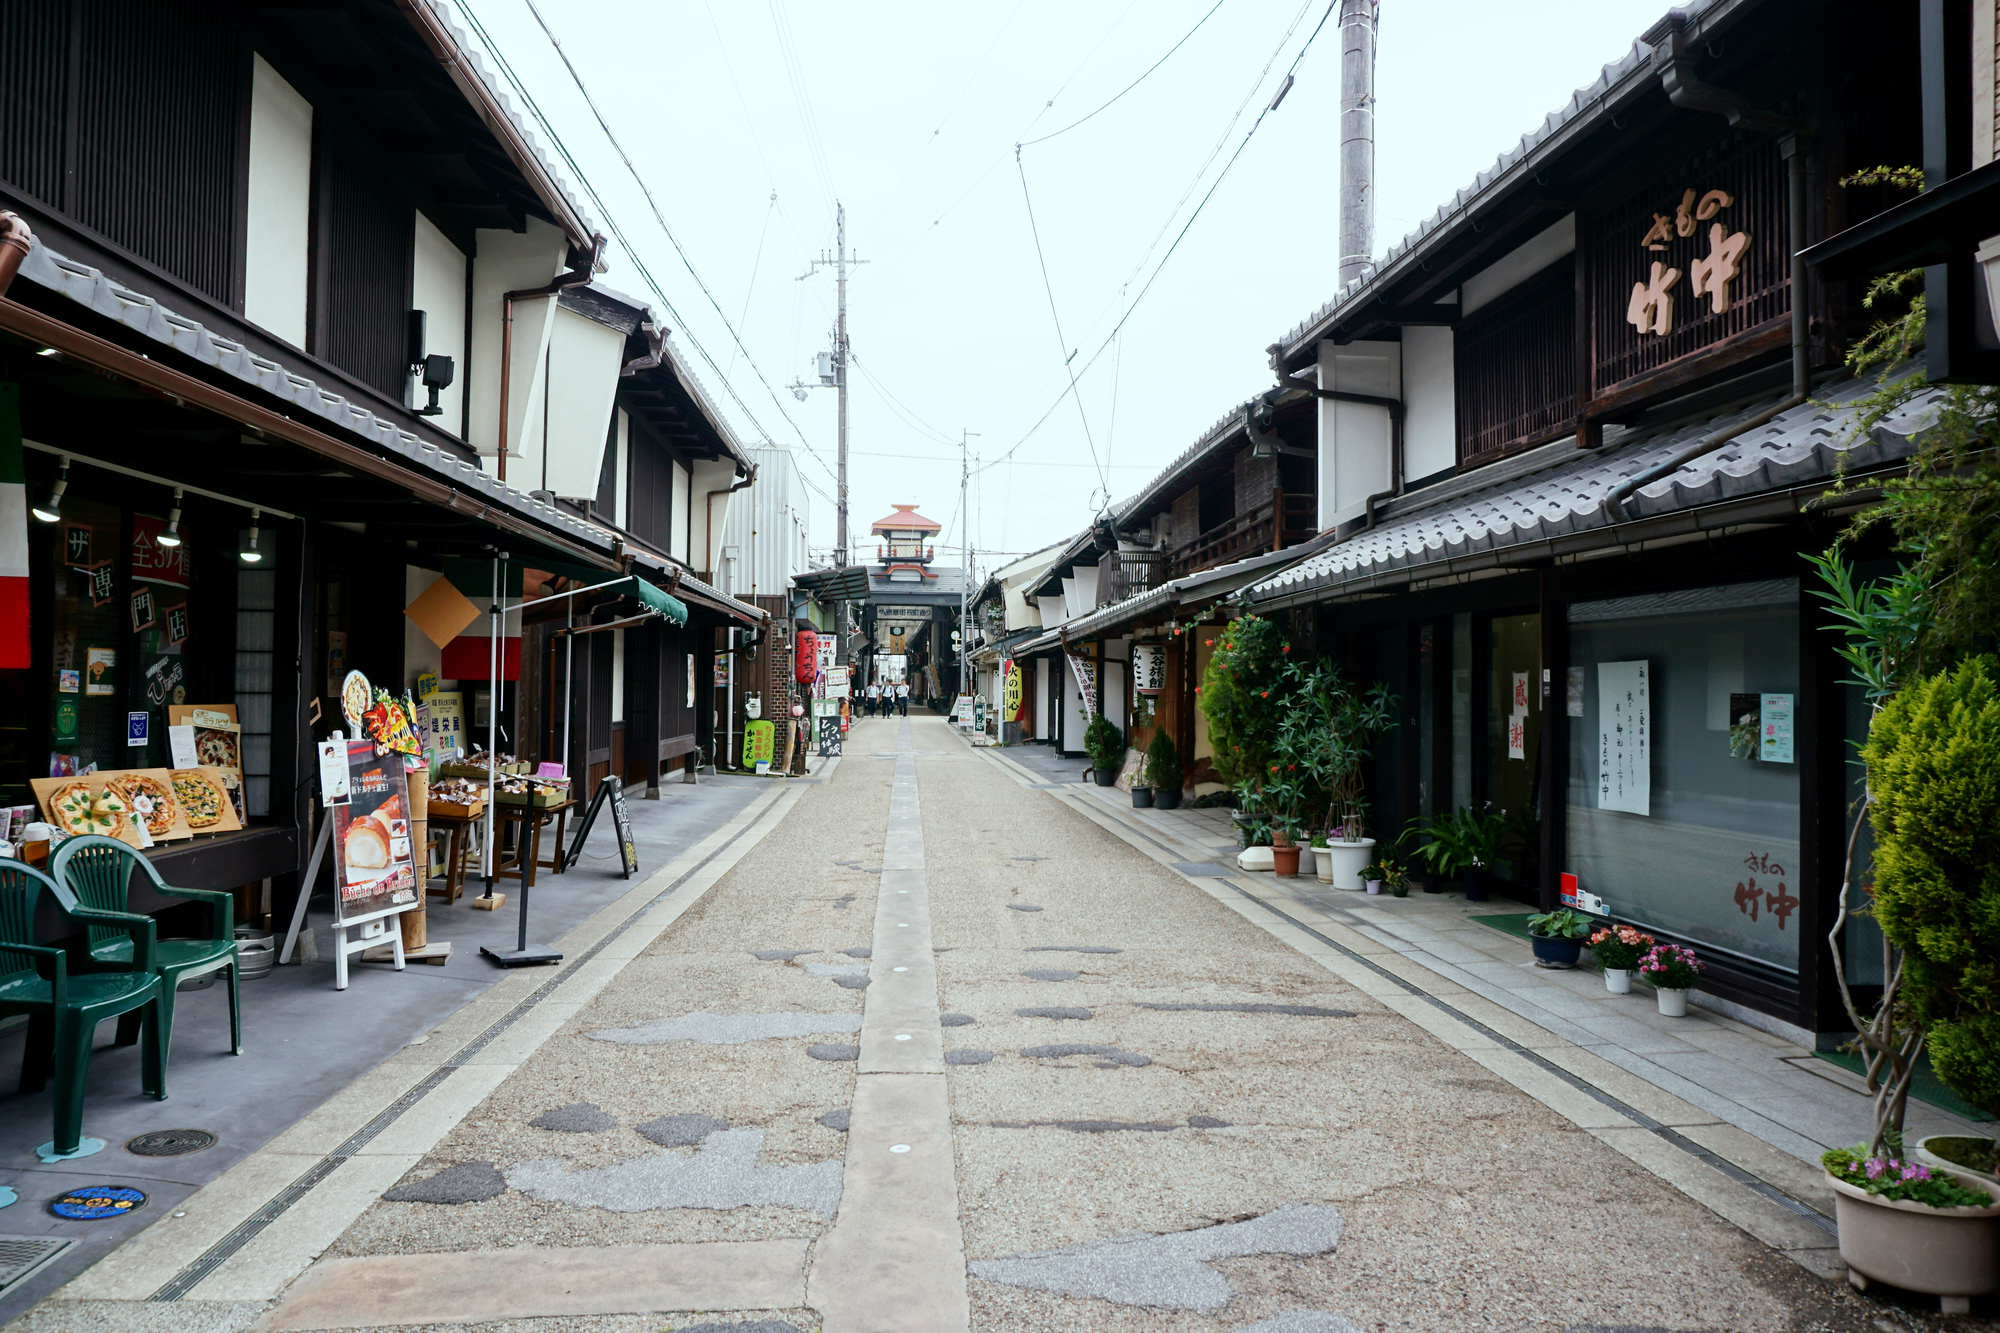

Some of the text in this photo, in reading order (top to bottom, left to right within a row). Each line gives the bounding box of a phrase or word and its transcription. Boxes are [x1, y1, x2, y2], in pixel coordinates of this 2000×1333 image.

[1641, 188, 1735, 252] きもの
[1626, 222, 1753, 336] 竹中
[802, 635, 815, 680] ちょうちん
[1149, 647, 1166, 688] 三谷旅館
[1008, 666, 1020, 711] 火の用心
[1509, 678, 1529, 749] 感謝
[745, 729, 755, 760] かさぜん
[754, 729, 763, 759] 製造販売
[762, 725, 772, 758] ちょうちん
[1744, 851, 1785, 877] きもの
[342, 885, 371, 902] Bûche
[373, 881, 385, 894] de
[1733, 877, 1800, 931] 竹中
